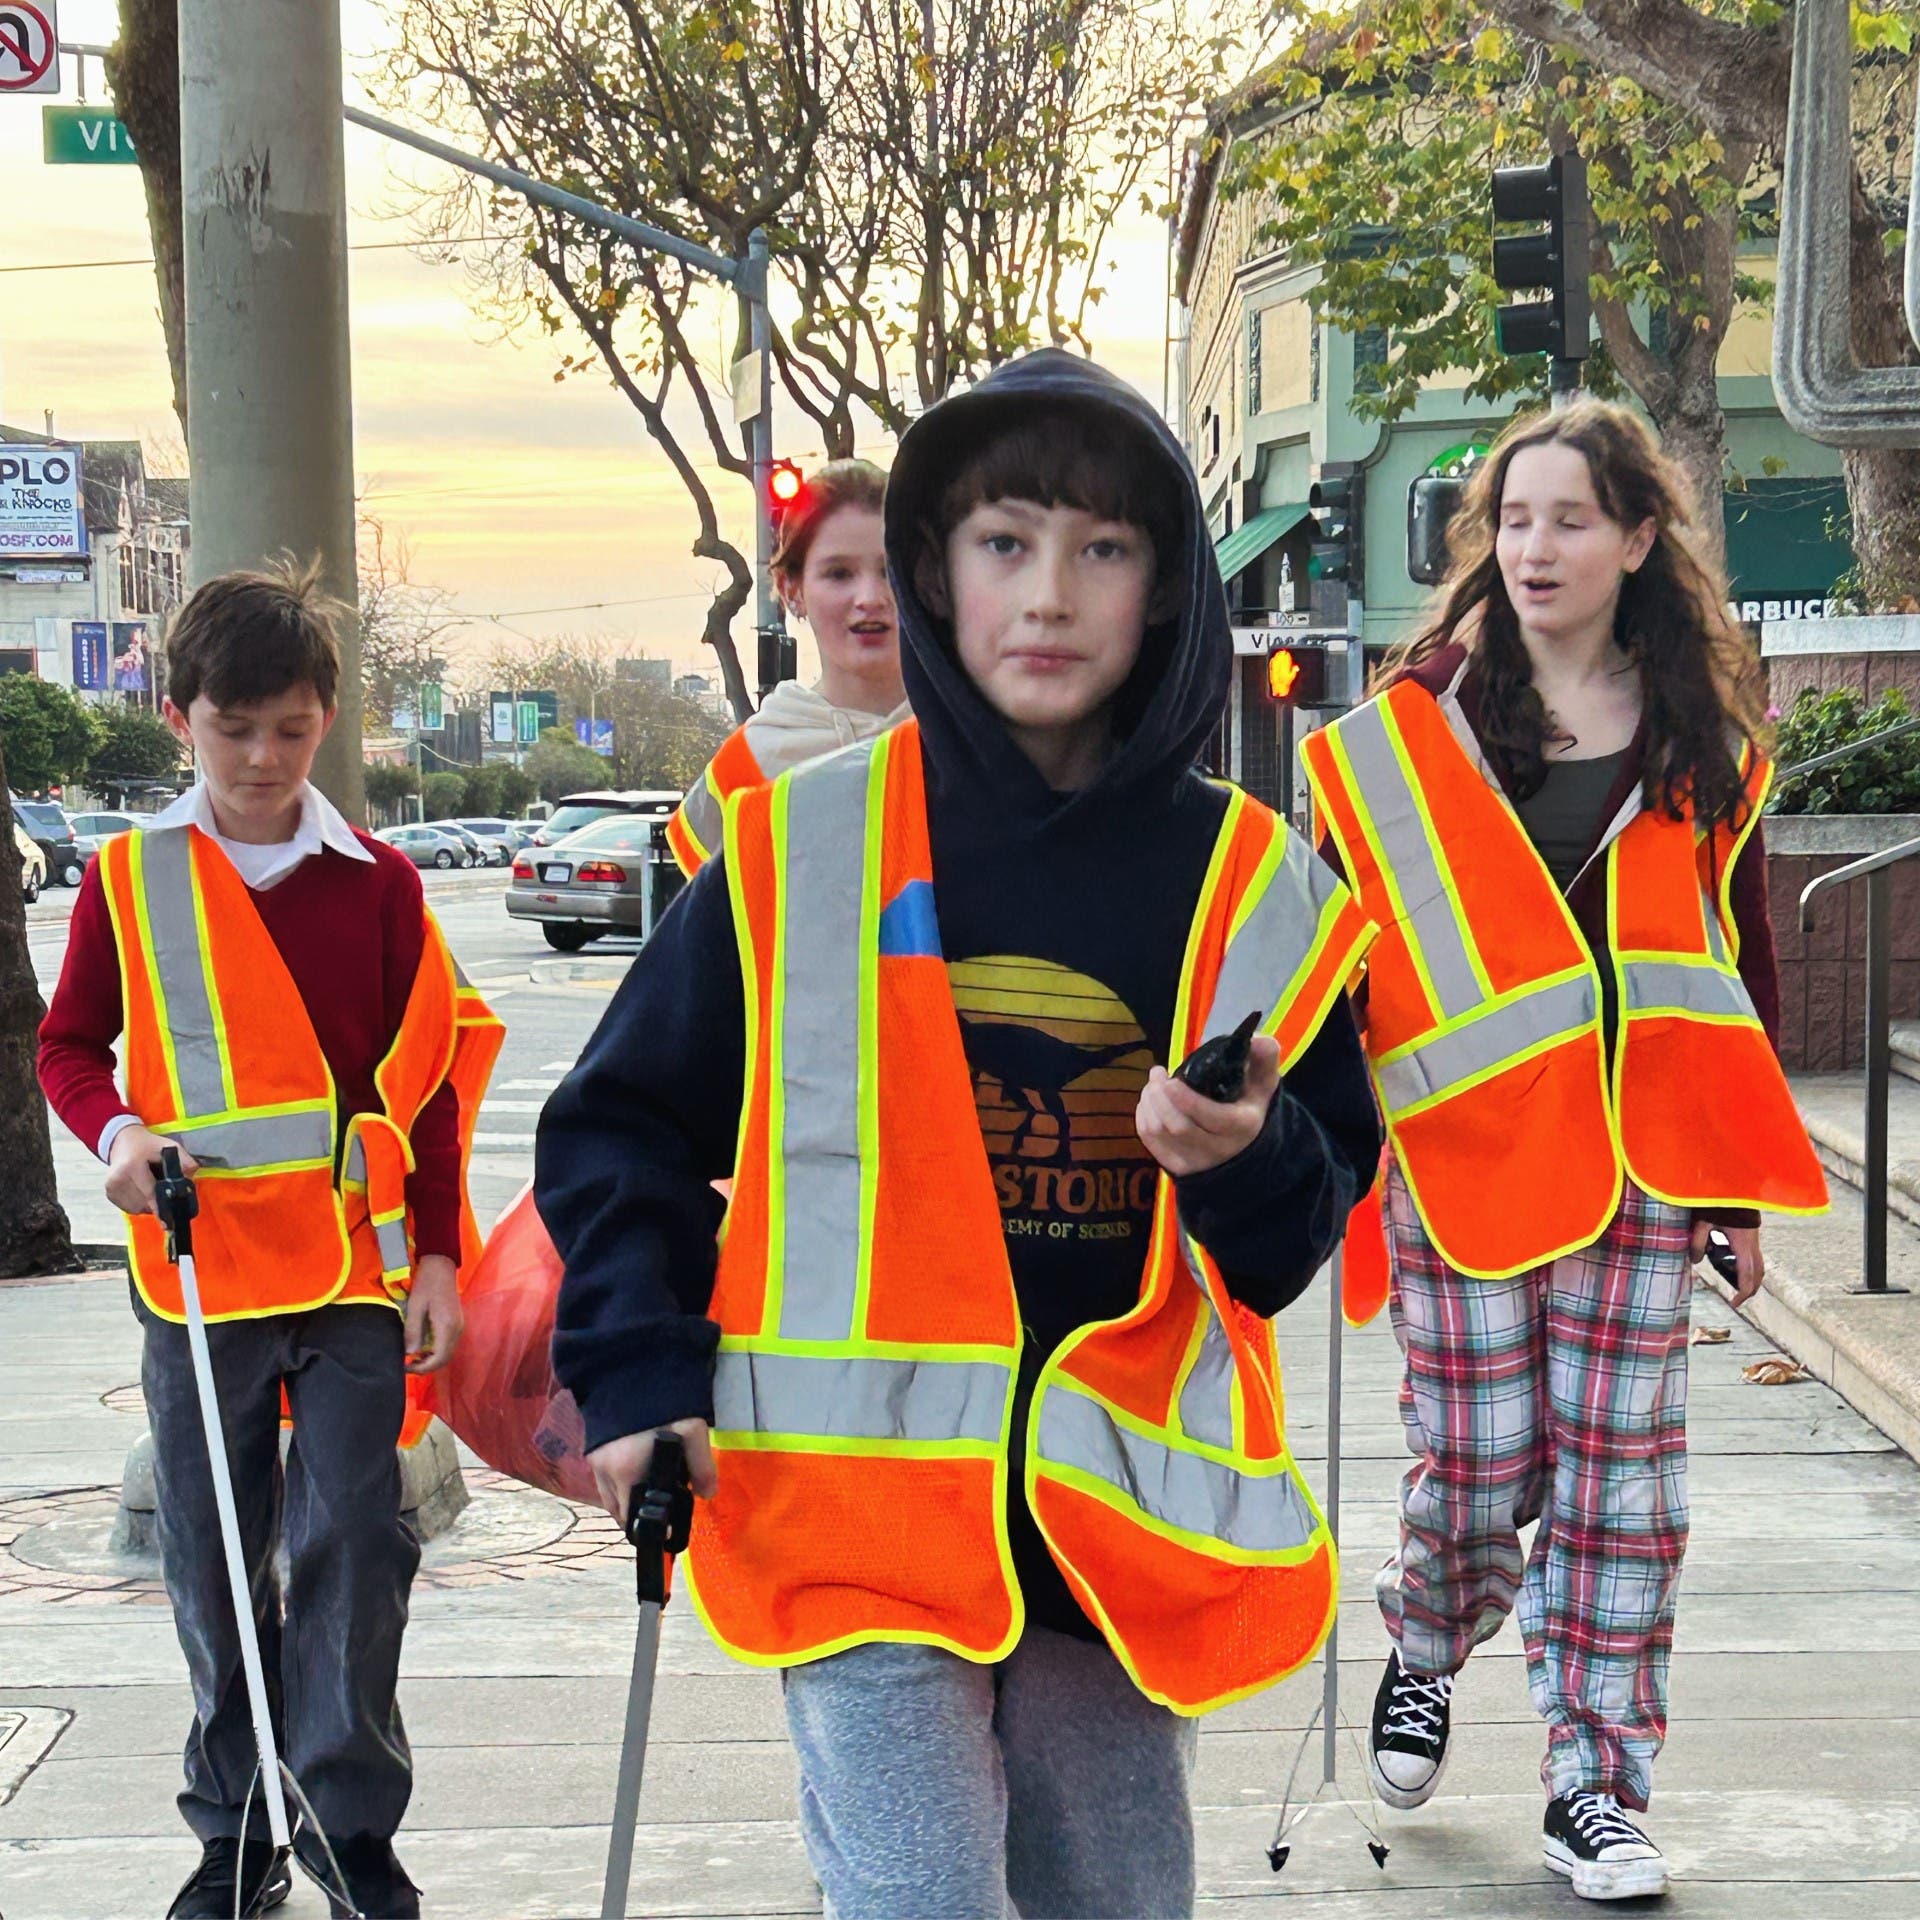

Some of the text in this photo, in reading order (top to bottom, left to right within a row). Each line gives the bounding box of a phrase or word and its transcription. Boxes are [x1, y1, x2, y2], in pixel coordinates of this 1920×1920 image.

[78, 121, 135, 151] Vi
[1002, 1218, 1043, 1236] EMY
[1047, 1221, 1074, 1238] OF
